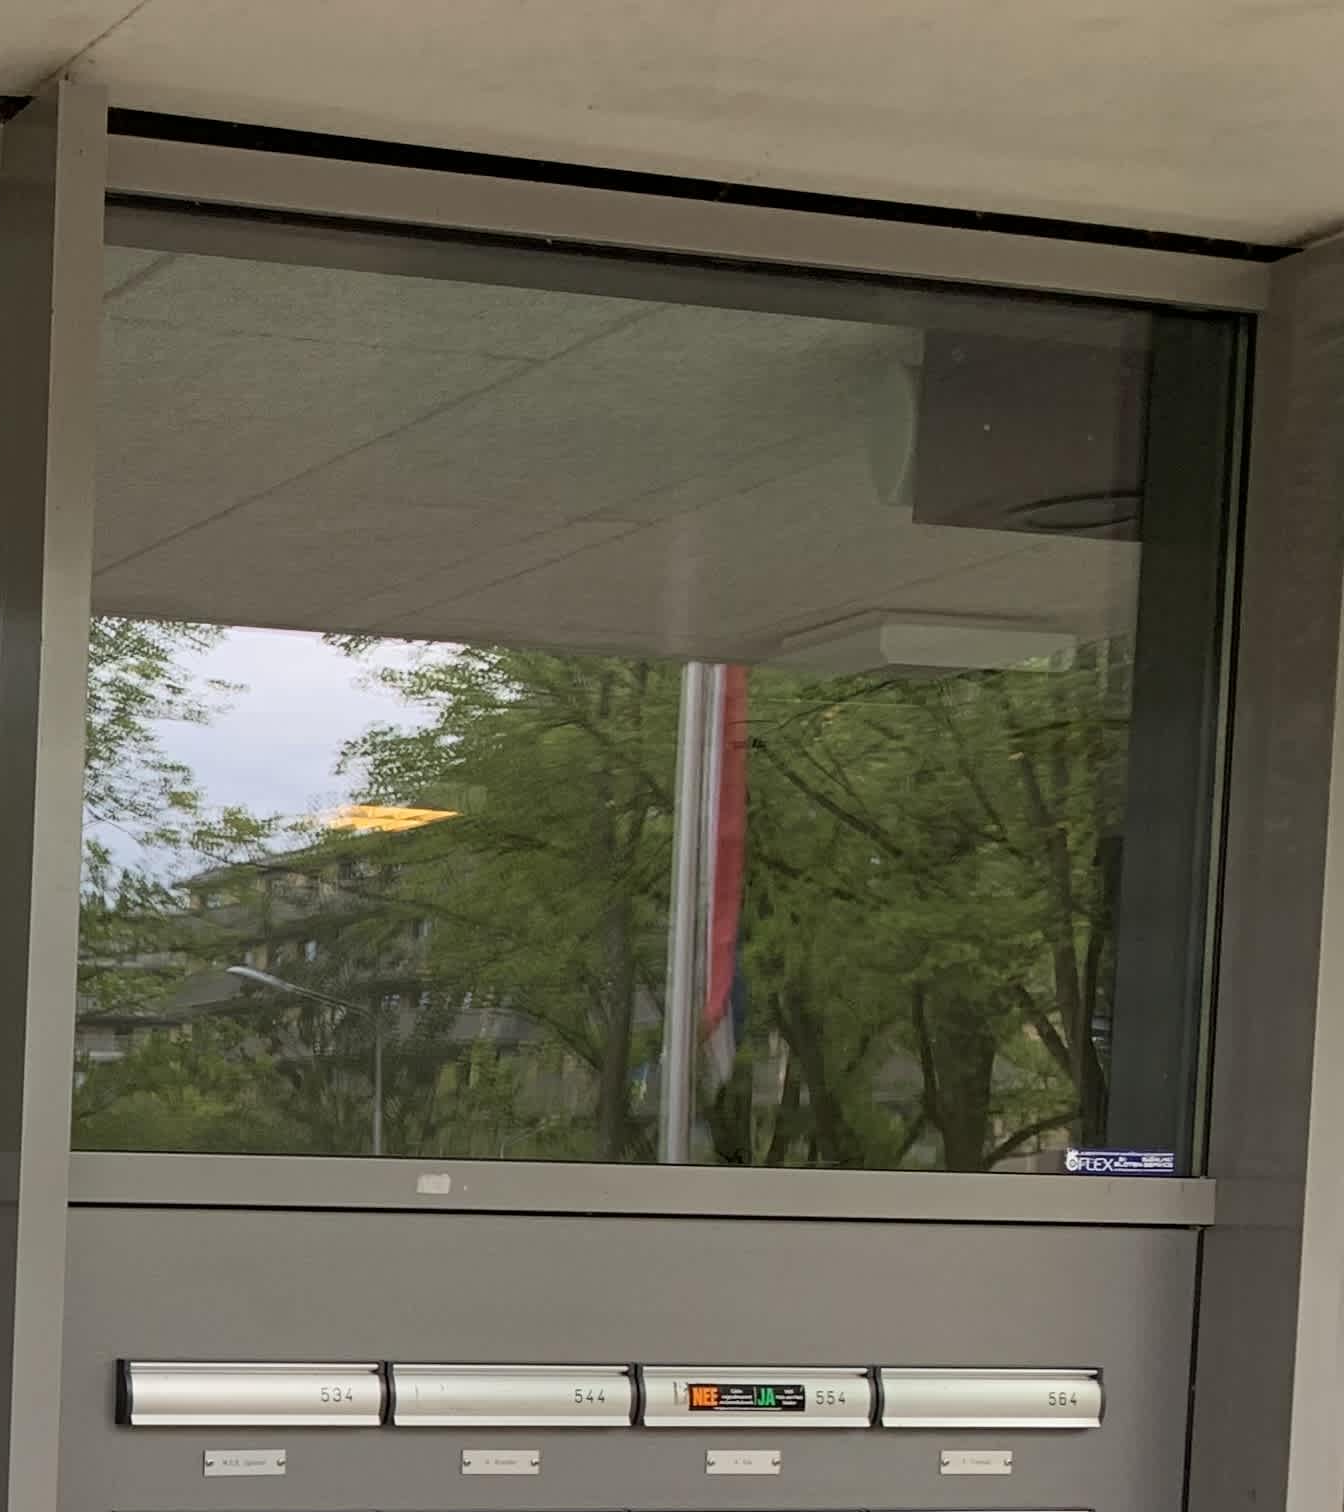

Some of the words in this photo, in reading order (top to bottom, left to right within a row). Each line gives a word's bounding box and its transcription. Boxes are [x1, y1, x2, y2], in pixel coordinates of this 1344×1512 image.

[320, 1387, 353, 1403] 534
[574, 1389, 606, 1405] 544
[692, 1387, 718, 1407] NEE
[758, 1388, 775, 1405] JA
[815, 1390, 846, 1406] 554
[1048, 1391, 1077, 1407] 564
